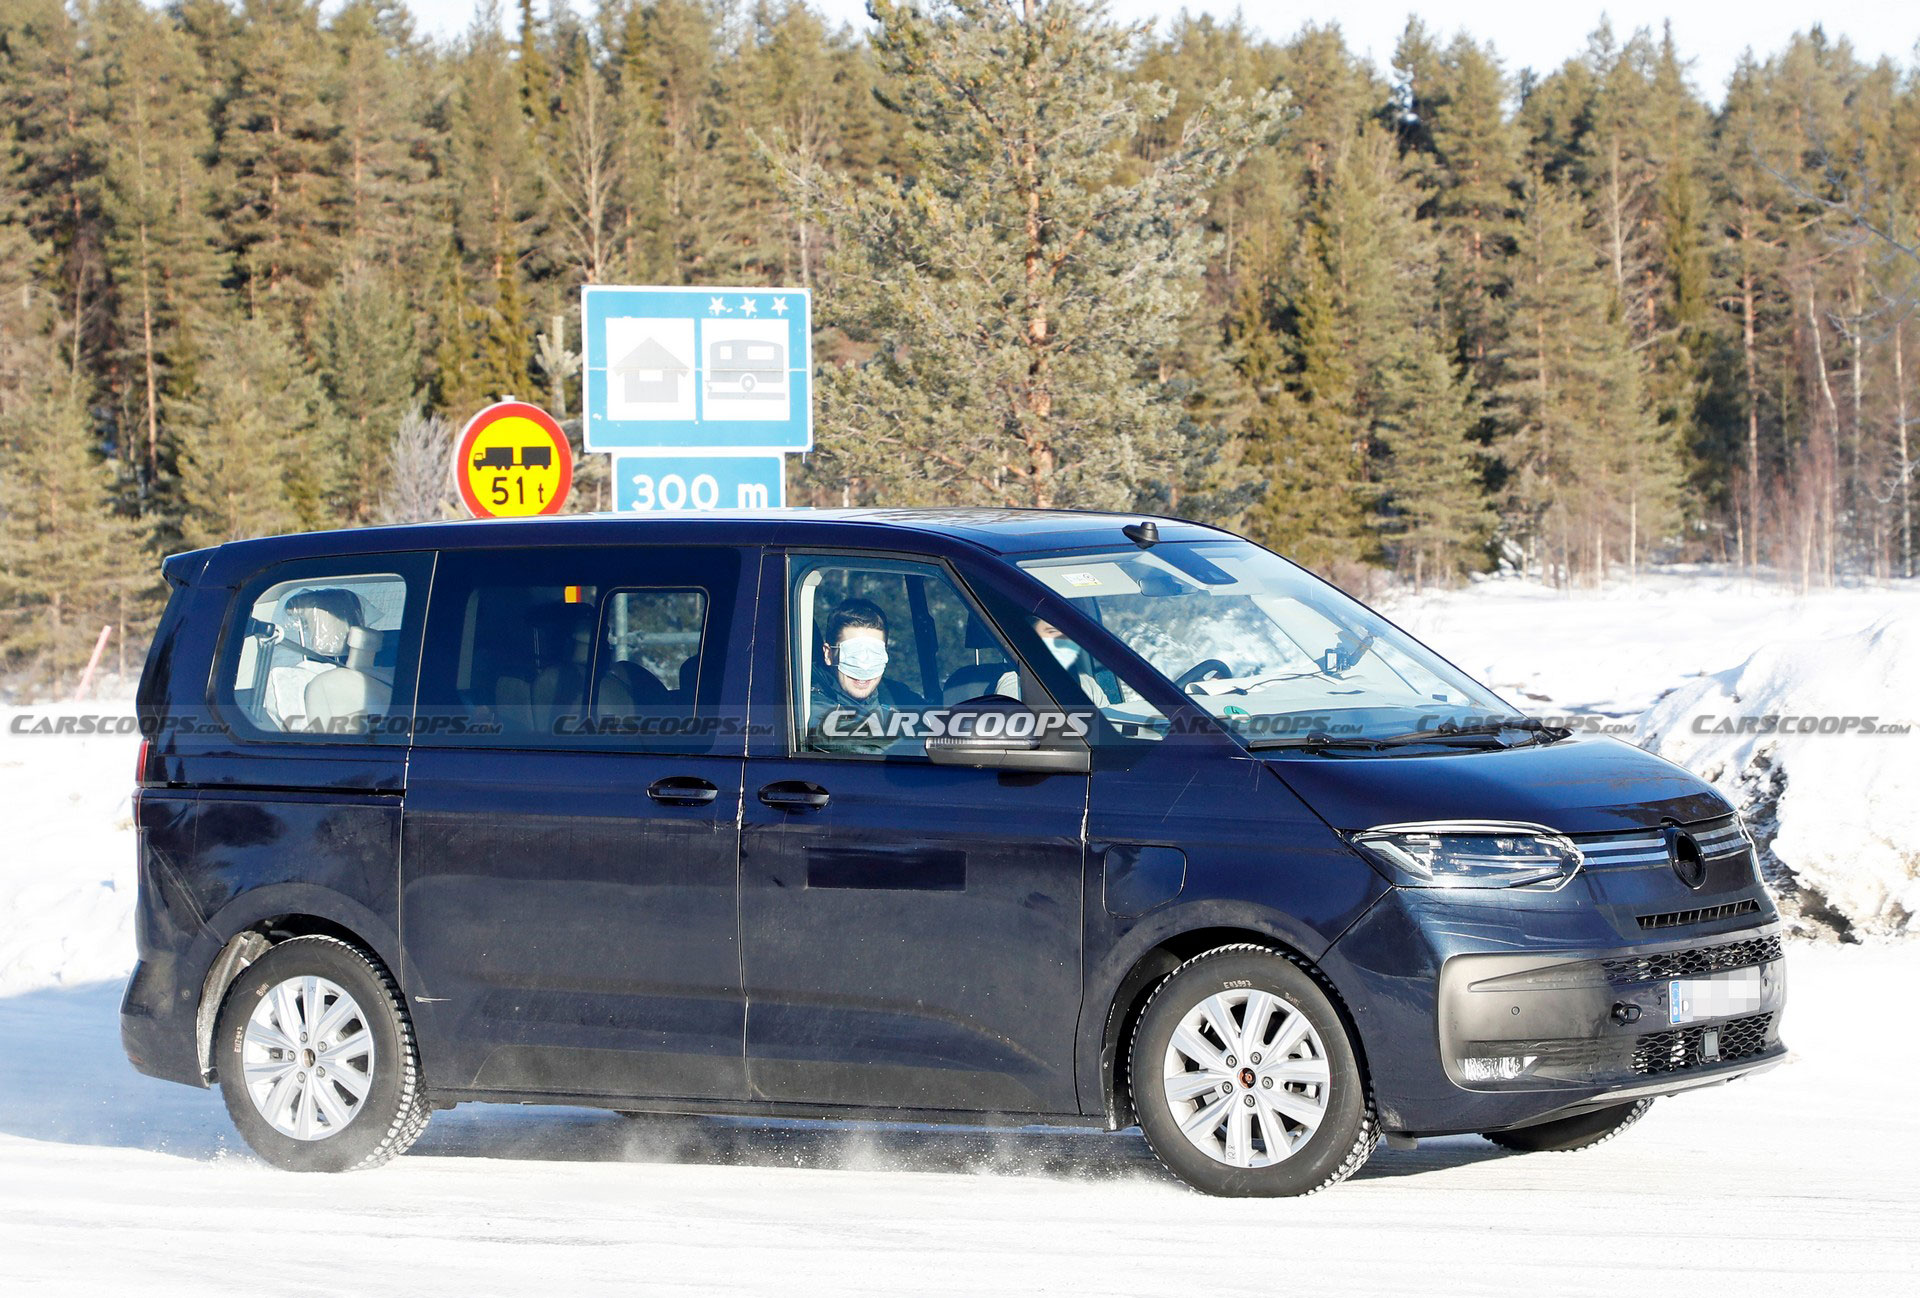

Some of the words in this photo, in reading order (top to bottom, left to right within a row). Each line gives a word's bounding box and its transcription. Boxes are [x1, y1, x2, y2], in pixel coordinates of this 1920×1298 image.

[491, 476, 524, 505] 51
[537, 482, 544, 504] t
[631, 473, 719, 510] 300
[737, 483, 768, 508] m
